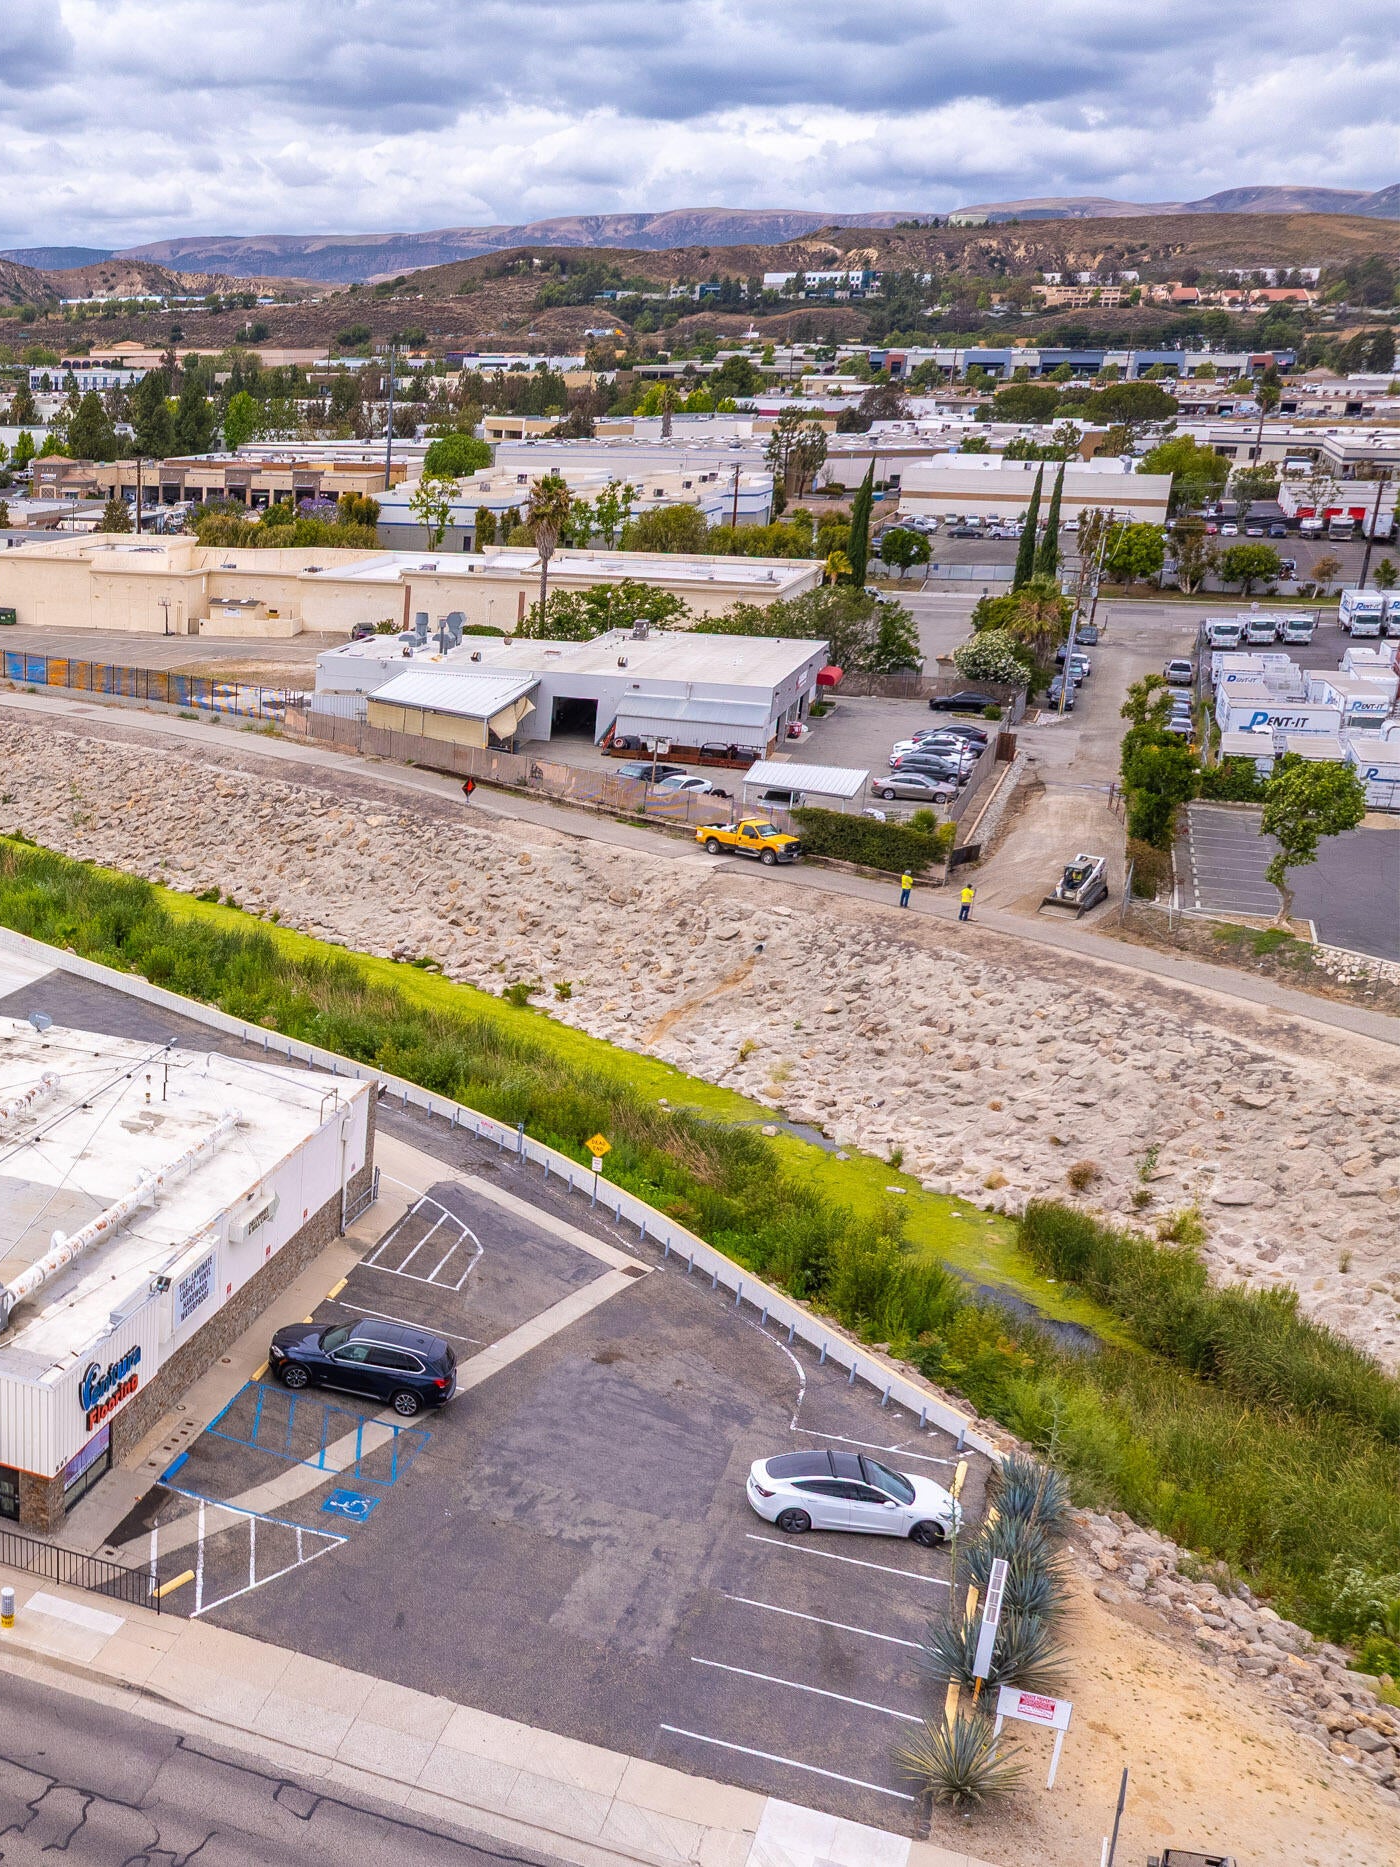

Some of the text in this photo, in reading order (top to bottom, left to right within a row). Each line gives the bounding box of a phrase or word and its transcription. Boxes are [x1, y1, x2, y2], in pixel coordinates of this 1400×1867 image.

[1351, 701, 1385, 710] RENT-IT
[179, 1255, 213, 1293] TILE LAMINATE
[180, 1267, 212, 1302] CARPET VINYL
[181, 1288, 209, 1322] WATERPROOF
[183, 1280, 208, 1311] HARDWOOD
[79, 1345, 141, 1412] Ventura
[86, 1373, 139, 1432] Flooring
